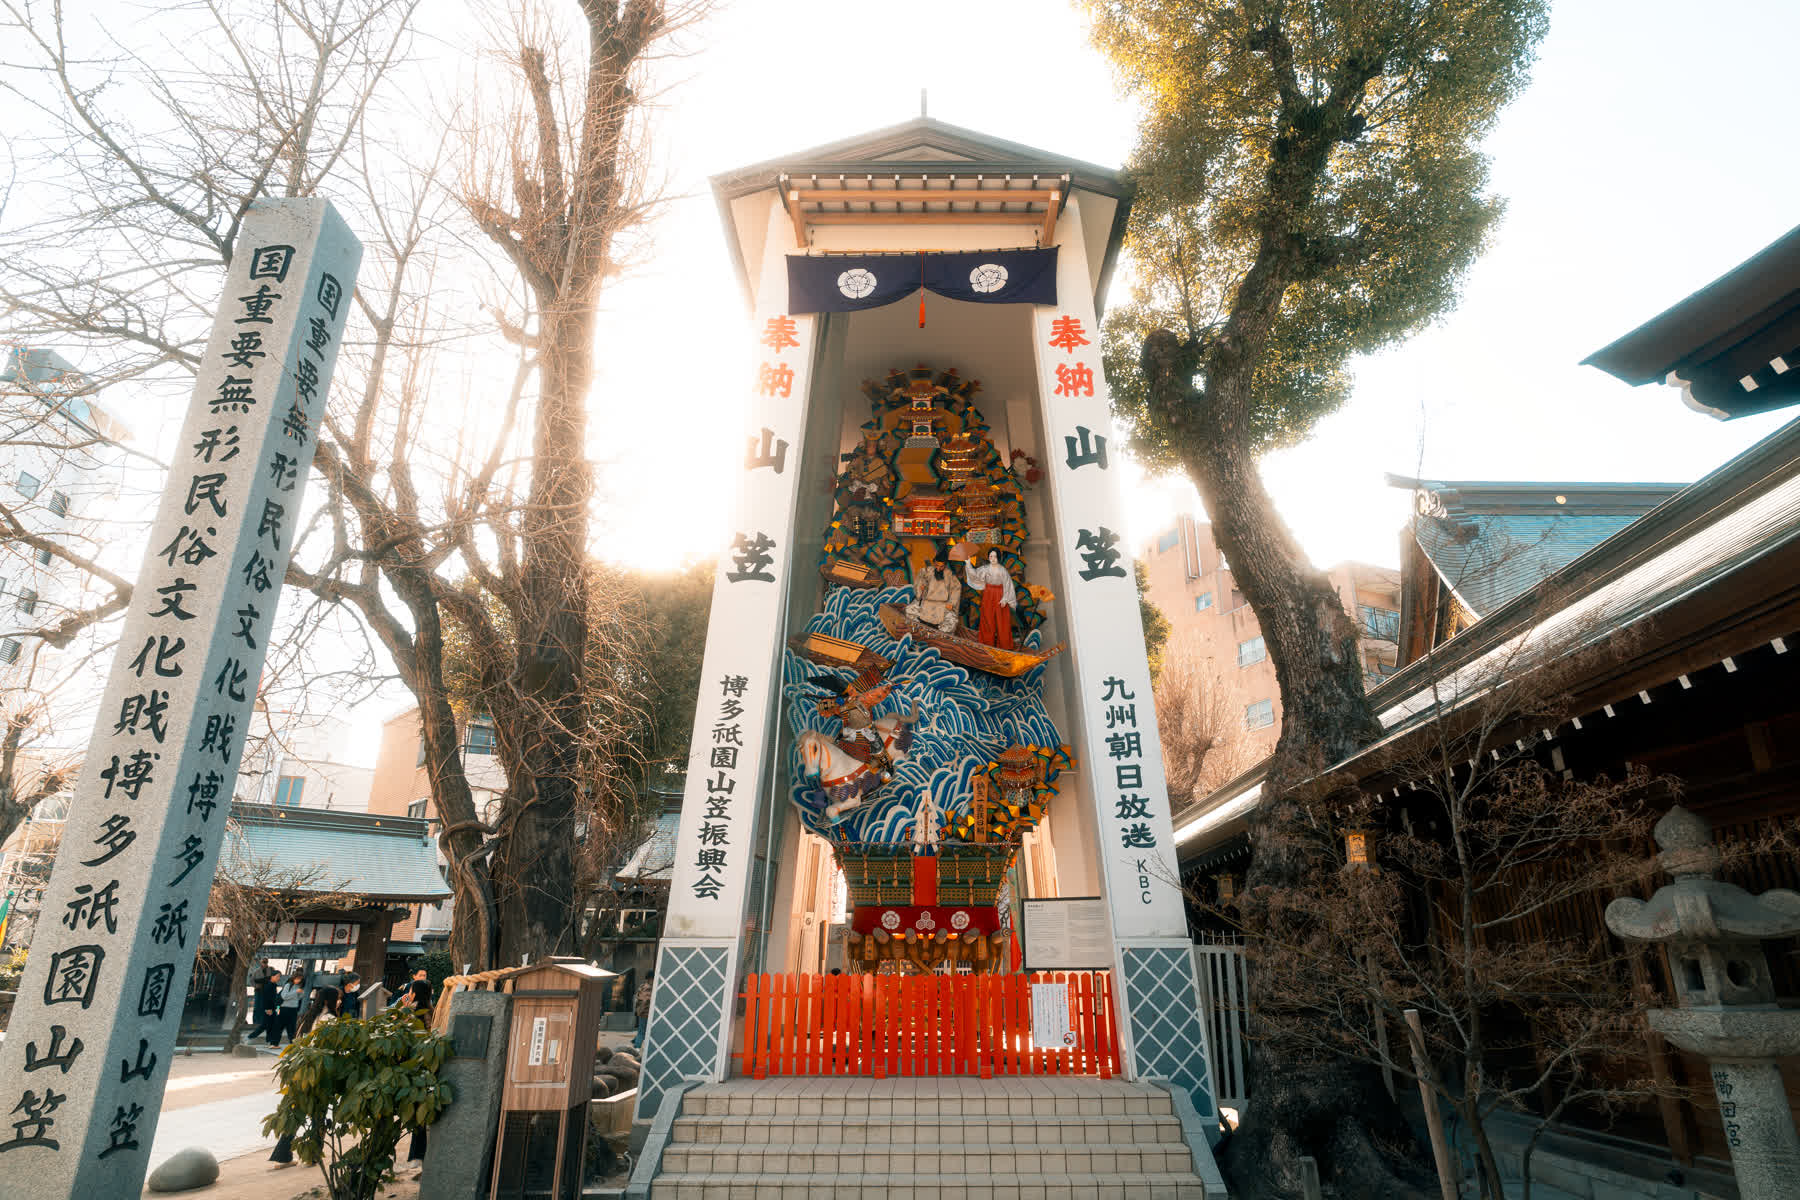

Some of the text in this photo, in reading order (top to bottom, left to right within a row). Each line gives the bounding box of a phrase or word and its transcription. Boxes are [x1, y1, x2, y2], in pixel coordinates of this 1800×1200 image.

[753, 315, 801, 398] 奉納
[1048, 315, 1095, 397] 奉納
[726, 427, 790, 583] 山笠
[1065, 425, 1127, 582] 山笠
[690, 674, 749, 900] 博多祇園山笠振興会
[1101, 676, 1157, 849] 九州朝日放送
